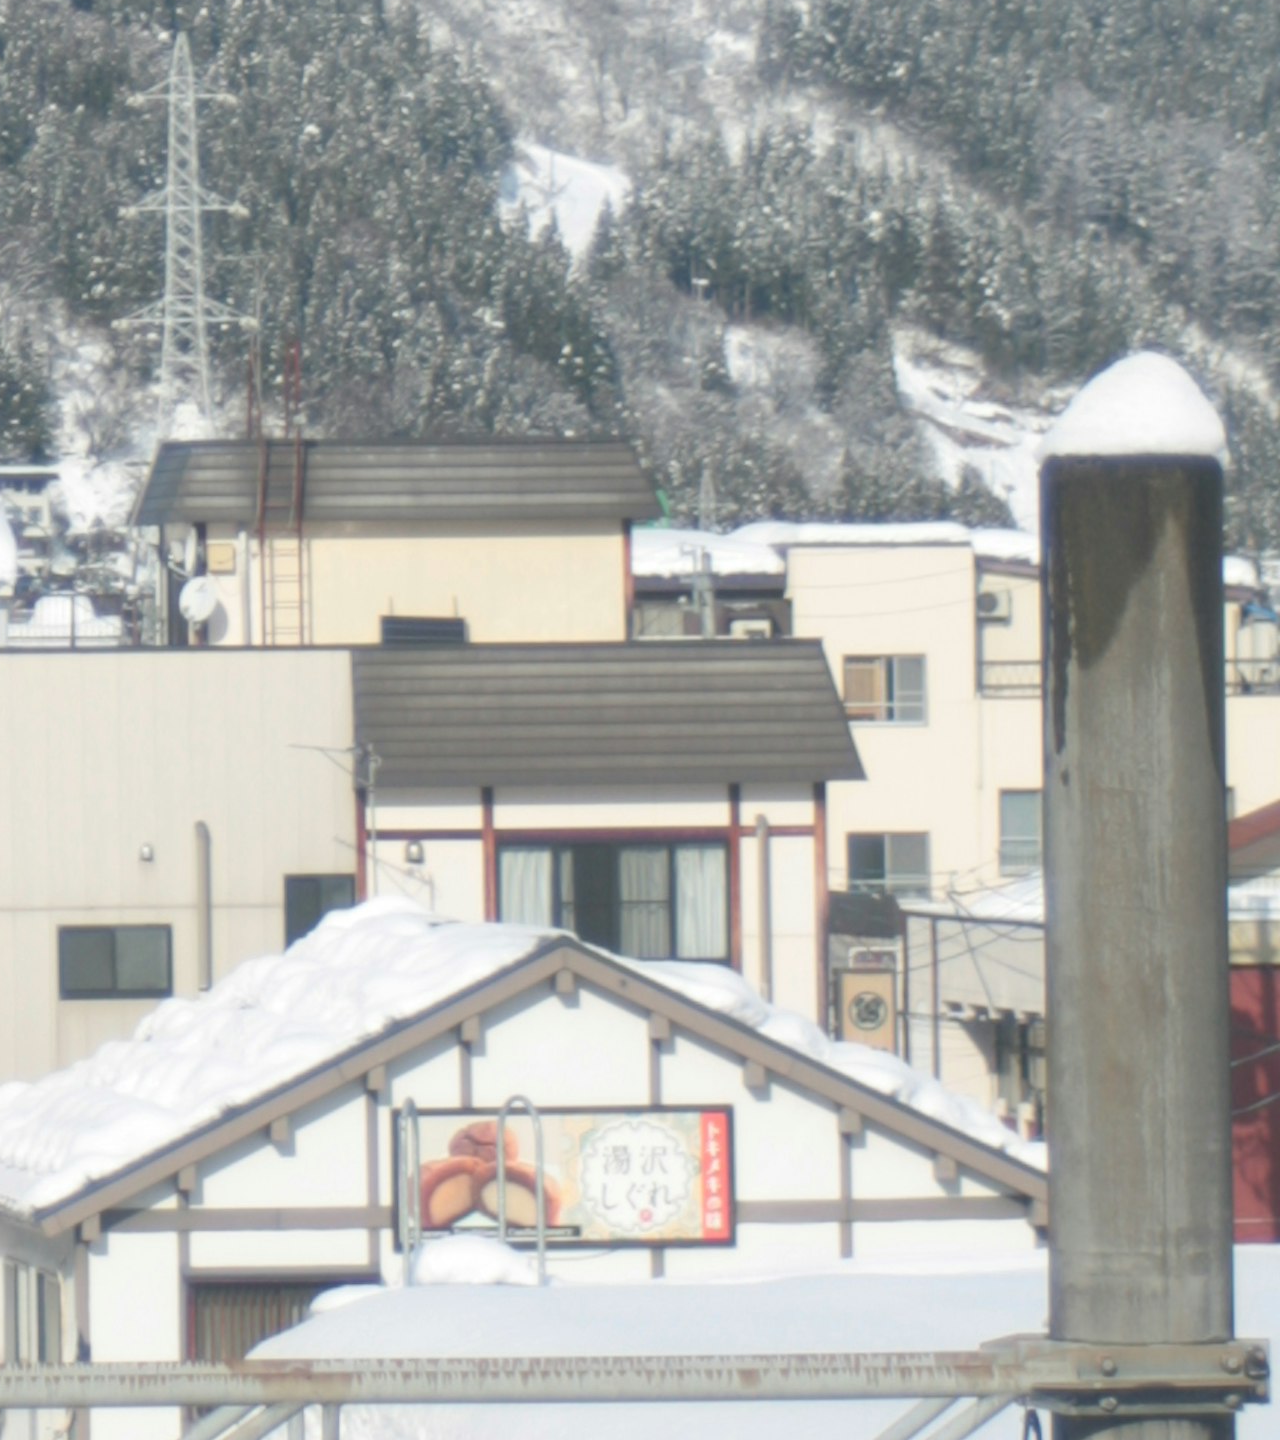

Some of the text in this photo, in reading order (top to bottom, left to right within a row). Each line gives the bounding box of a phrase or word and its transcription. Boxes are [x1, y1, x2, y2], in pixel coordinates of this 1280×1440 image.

[602, 1145, 668, 1175] 湯沢
[602, 1181, 672, 1210] しぐれ
